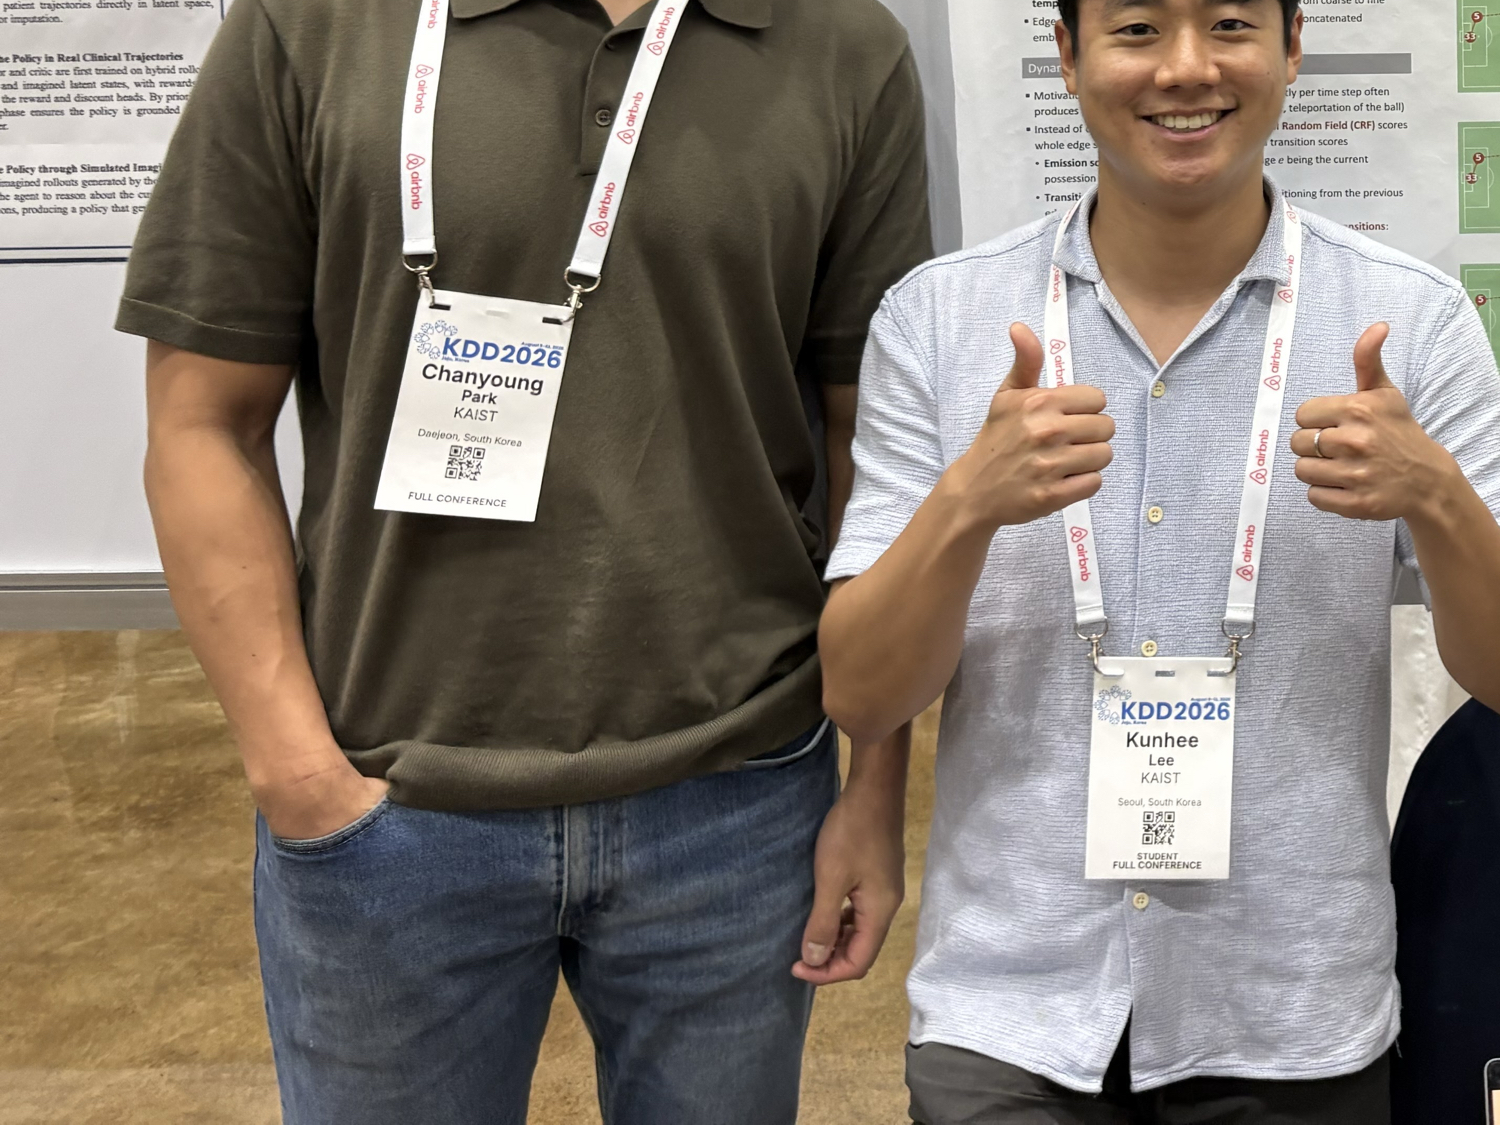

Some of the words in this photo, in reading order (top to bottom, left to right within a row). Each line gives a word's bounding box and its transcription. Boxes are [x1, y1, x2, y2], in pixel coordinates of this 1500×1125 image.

[657, 7, 675, 40] airbnb
[415, 80, 425, 113] airbnb
[626, 92, 644, 128] airbnb
[411, 172, 420, 209] airbnb
[598, 182, 615, 219] airbnb
[442, 337, 561, 368] KDD2026
[1270, 338, 1282, 374] airbnb
[422, 363, 544, 395] Chanyoung
[1054, 355, 1066, 387] airbn
[461, 389, 497, 405] Park
[454, 407, 498, 422] KAIST
[418, 428, 460, 442] Daejeon,
[464, 432, 492, 444] South
[495, 436, 522, 447] Korea
[1257, 429, 1269, 466] airbnb
[408, 491, 433, 502] FULL
[437, 494, 507, 508] CONFERENCE
[1243, 525, 1255, 562] airbnb
[1076, 543, 1088, 581] airbnb
[1121, 701, 1230, 721] KDD2026
[1126, 732, 1199, 748] Kunhee
[1149, 754, 1174, 766] Lee
[1141, 772, 1181, 784] KAIST
[1118, 798, 1144, 807] Seoul,
[1148, 798, 1173, 807] South
[1176, 798, 1202, 807] Korea
[1138, 861, 1202, 869] CONFERENCE
